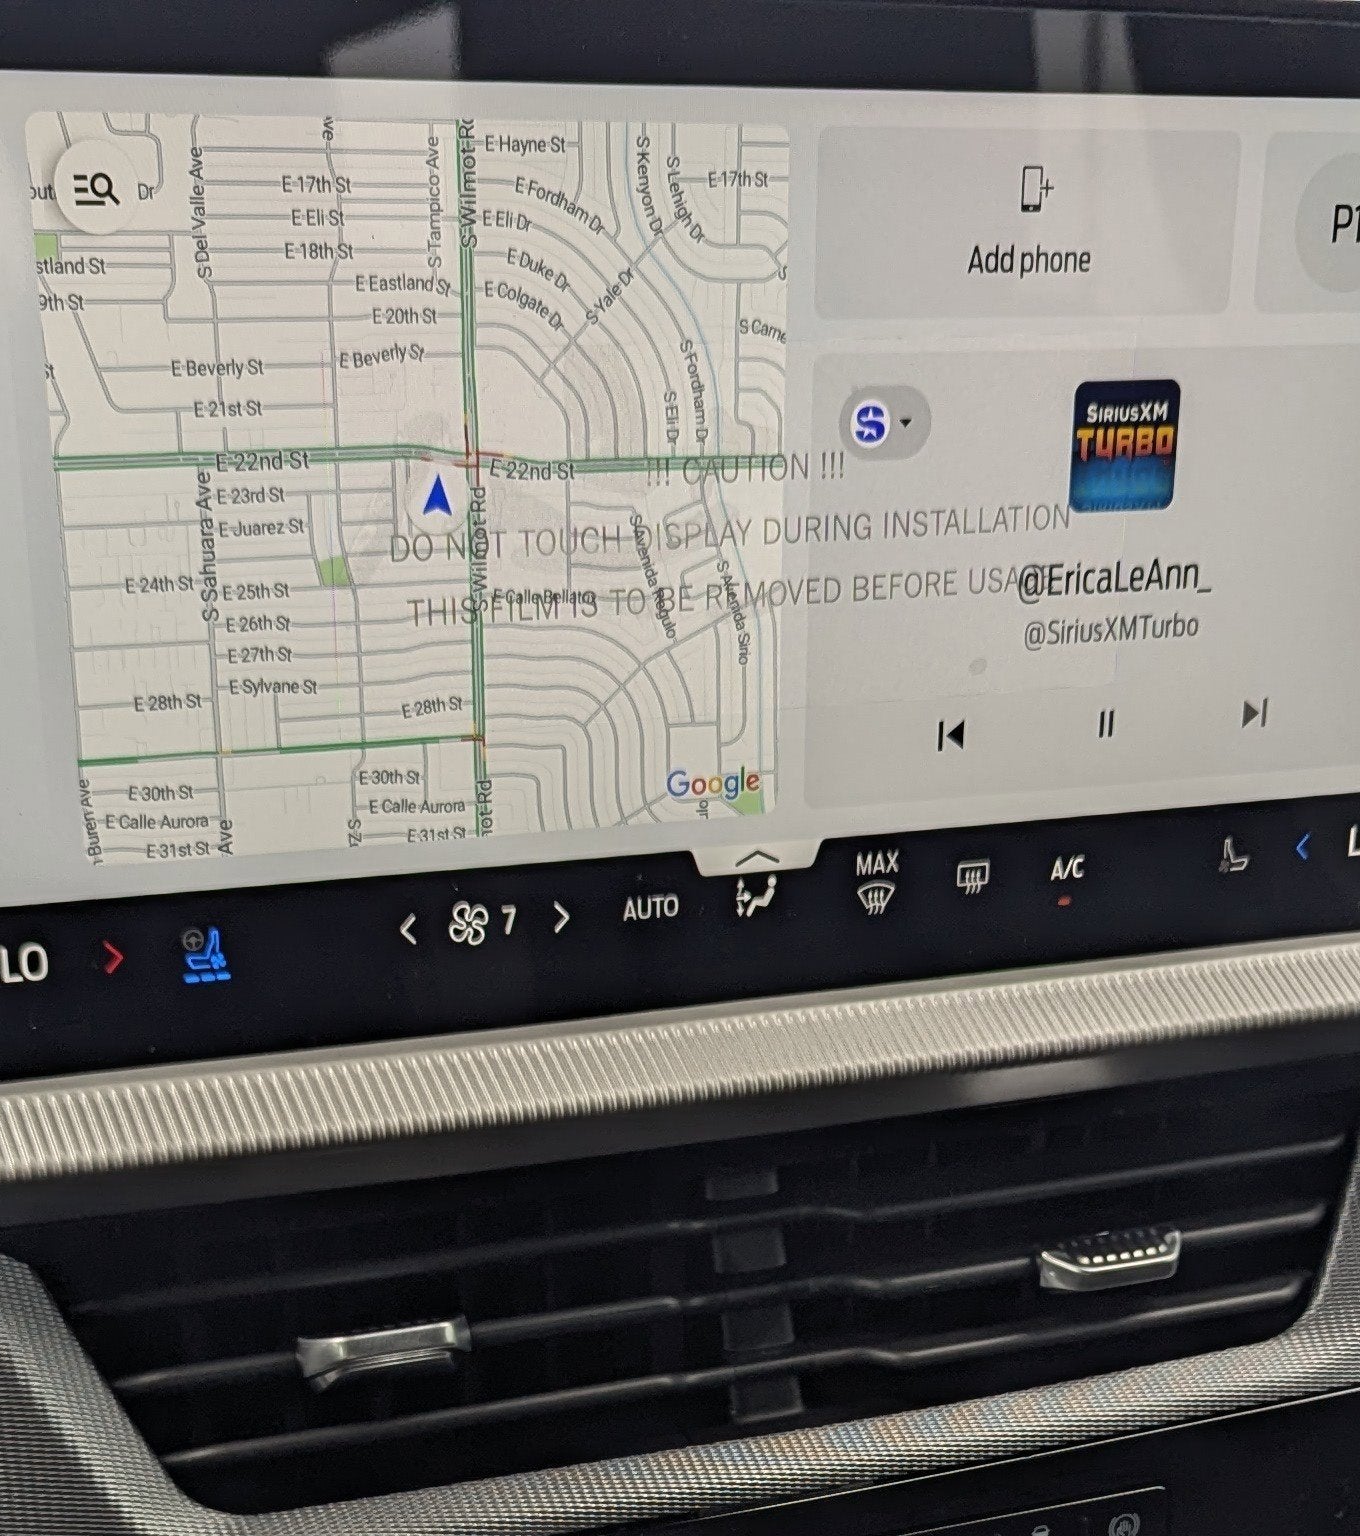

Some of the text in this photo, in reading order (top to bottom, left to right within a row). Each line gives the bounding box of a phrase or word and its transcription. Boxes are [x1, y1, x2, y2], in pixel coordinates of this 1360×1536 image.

[485, 135, 565, 156] E Hayne St
[283, 175, 351, 193] E 17th St
[460, 147, 477, 227] Wilmot
[636, 137, 664, 236] S Kenyon Dr
[708, 171, 768, 188] E 17th St
[426, 136, 443, 268] S Tampico Ave
[516, 177, 605, 235] E Fordham Dr
[667, 156, 705, 244] S Lehigh Dr
[189, 147, 212, 279] S Del Valle Ave
[292, 209, 344, 226] E Eli St
[483, 211, 533, 231] E Eli Dr
[285, 243, 353, 260] E 18th St
[461, 234, 477, 248] S
[507, 249, 571, 292] E Duke Dr
[968, 244, 1091, 279] Add phone
[356, 275, 451, 297] E Eastland St
[585, 267, 634, 325] S Yale Dr
[373, 309, 437, 324] E 20th St
[485, 283, 564, 331] E Colgate Dr
[340, 344, 425, 368] E Beverly St
[171, 360, 264, 379] E Beverly St
[681, 340, 709, 444] S Fordham Dr
[194, 401, 263, 418] E 21st St
[664, 391, 680, 444] S Eli Dr
[1076, 426, 1174, 462] TURBO
[216, 451, 309, 472] E 22nd St
[490, 458, 575, 481] E 22nd St
[646, 452, 846, 487] !!! CAUTION !!!
[217, 486, 285, 504] E 23rd St
[219, 519, 304, 538] E Juarez St
[390, 505, 1071, 563] DO NOT TOUCH DISPLAY DURING INSTALLATION
[196, 472, 219, 622] S Sahuara Ave
[126, 576, 194, 594] E 24th St
[223, 583, 290, 601] E 25th St
[1018, 557, 1212, 605] @EricaLeAnn_
[407, 564, 1054, 628] THIS FILM IS TO BE REMOVED BEFORE USAE
[226, 616, 291, 633] E 26th St
[1024, 612, 1199, 651] @SiriusXMTurbo
[228, 647, 292, 664] E 27th St
[229, 678, 317, 697] E Sylvane St
[134, 694, 203, 712] E 28th St
[129, 784, 194, 802] E 30th St
[666, 766, 760, 800] Google
[370, 799, 466, 815] E Calle Aurora
[106, 813, 209, 830] E Calle Aurora
[855, 850, 898, 877] MAX
[1050, 855, 1085, 882] A/C
[501, 905, 517, 934] 7
[622, 895, 679, 924] AUTO
